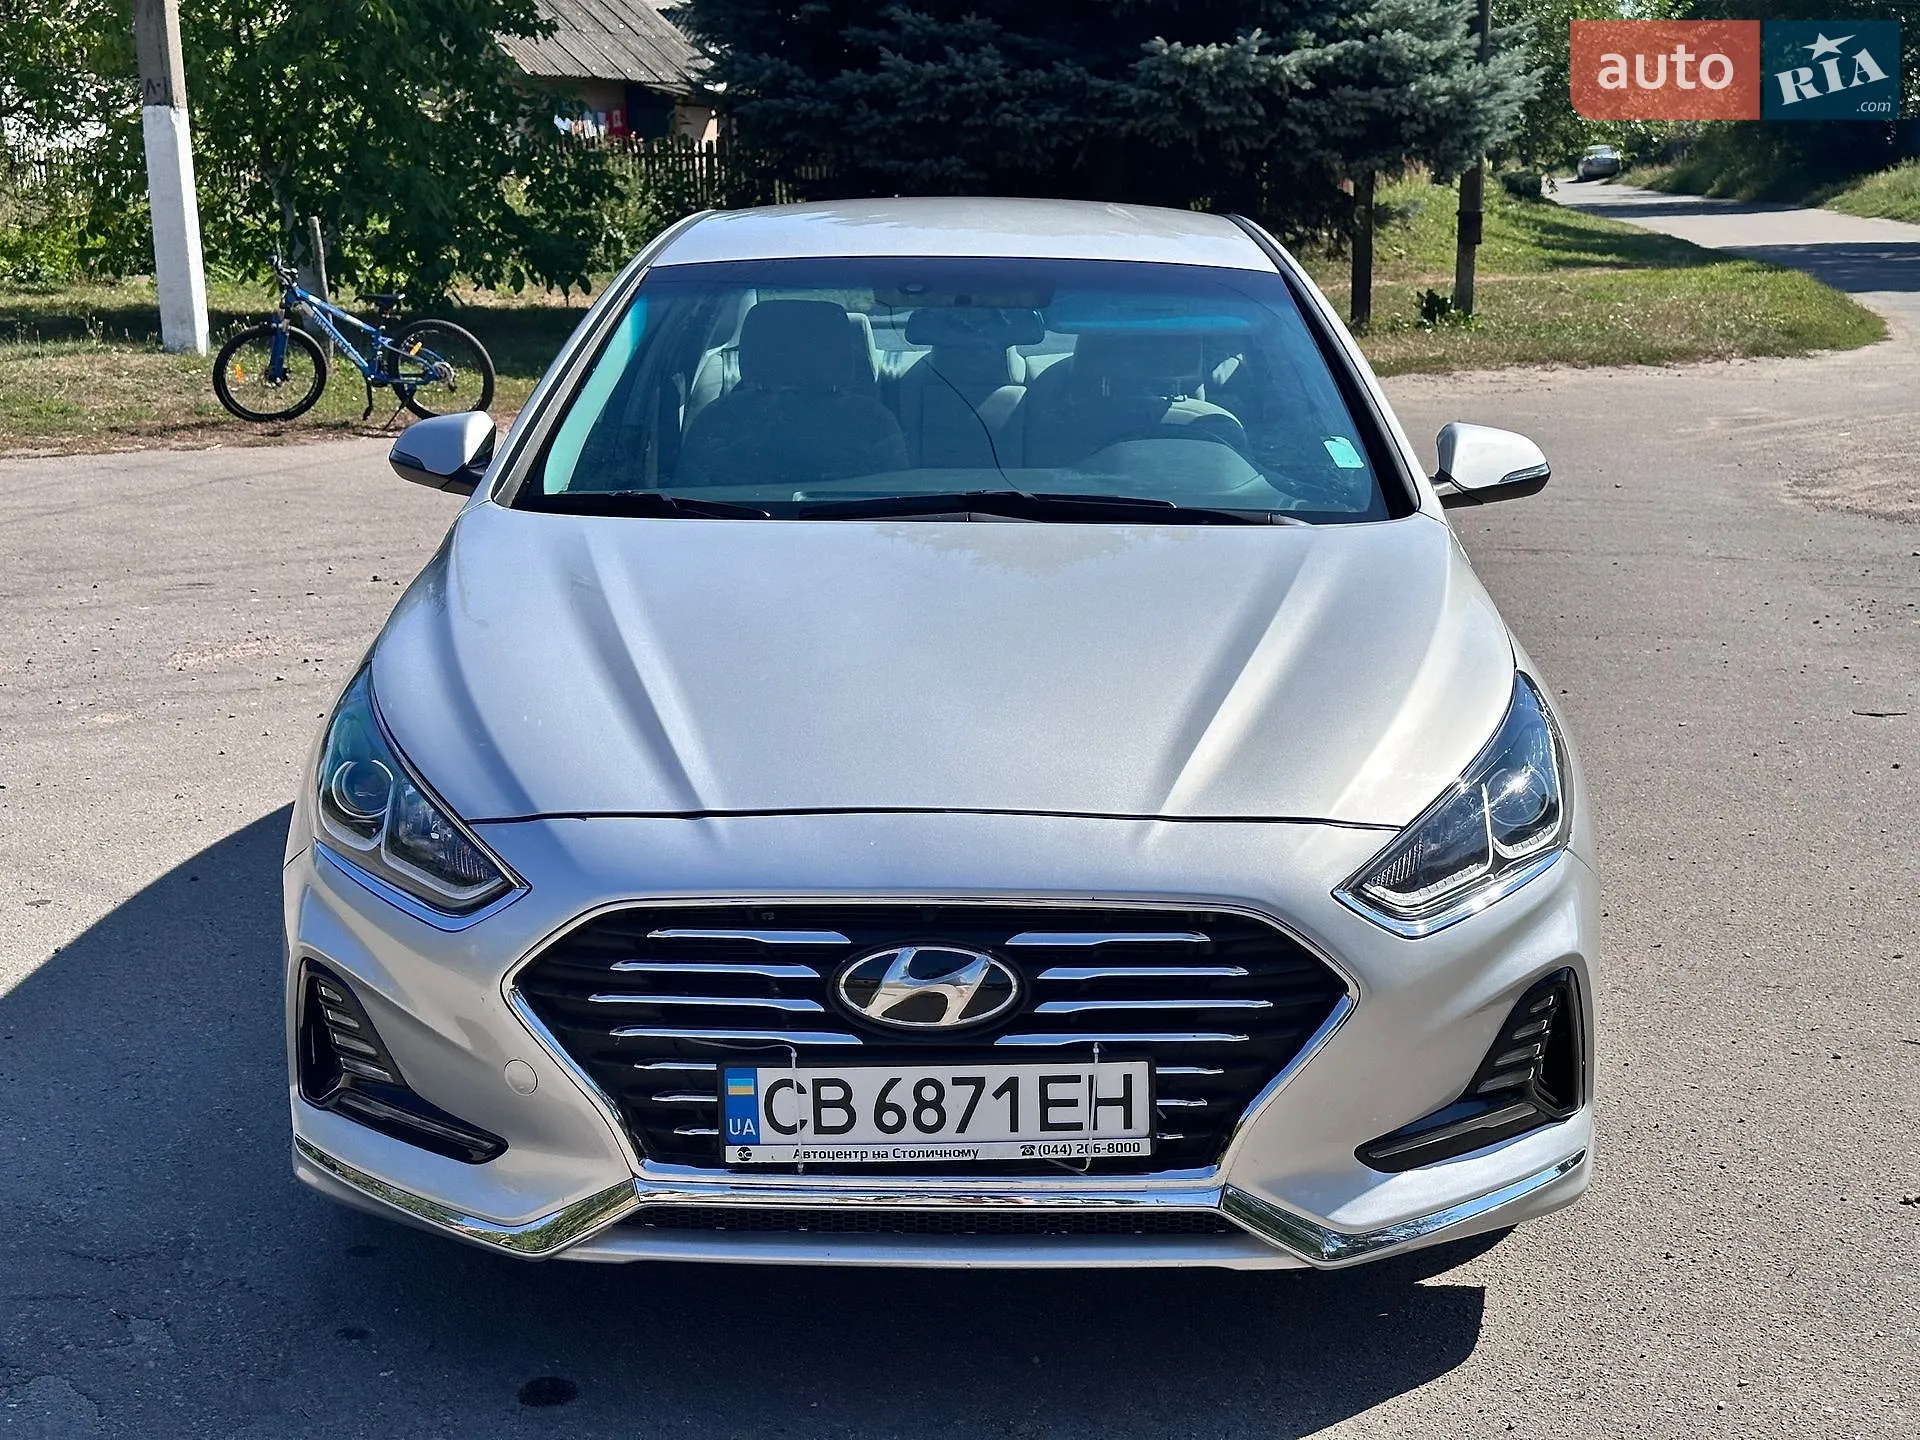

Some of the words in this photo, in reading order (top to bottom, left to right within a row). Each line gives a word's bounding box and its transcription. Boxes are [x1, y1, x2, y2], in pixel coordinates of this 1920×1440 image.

[764, 1078, 857, 1135] CB
[873, 1076, 1020, 1134] 6871
[1038, 1073, 1133, 1132] EH
[728, 1118, 756, 1136] UA
[793, 1149, 869, 1161] Автоцентр
[872, 1149, 889, 1159] на
[892, 1147, 980, 1160] Столичному
[1037, 1142, 1072, 1156] (044)
[1076, 1142, 1141, 1155] 206-8000
